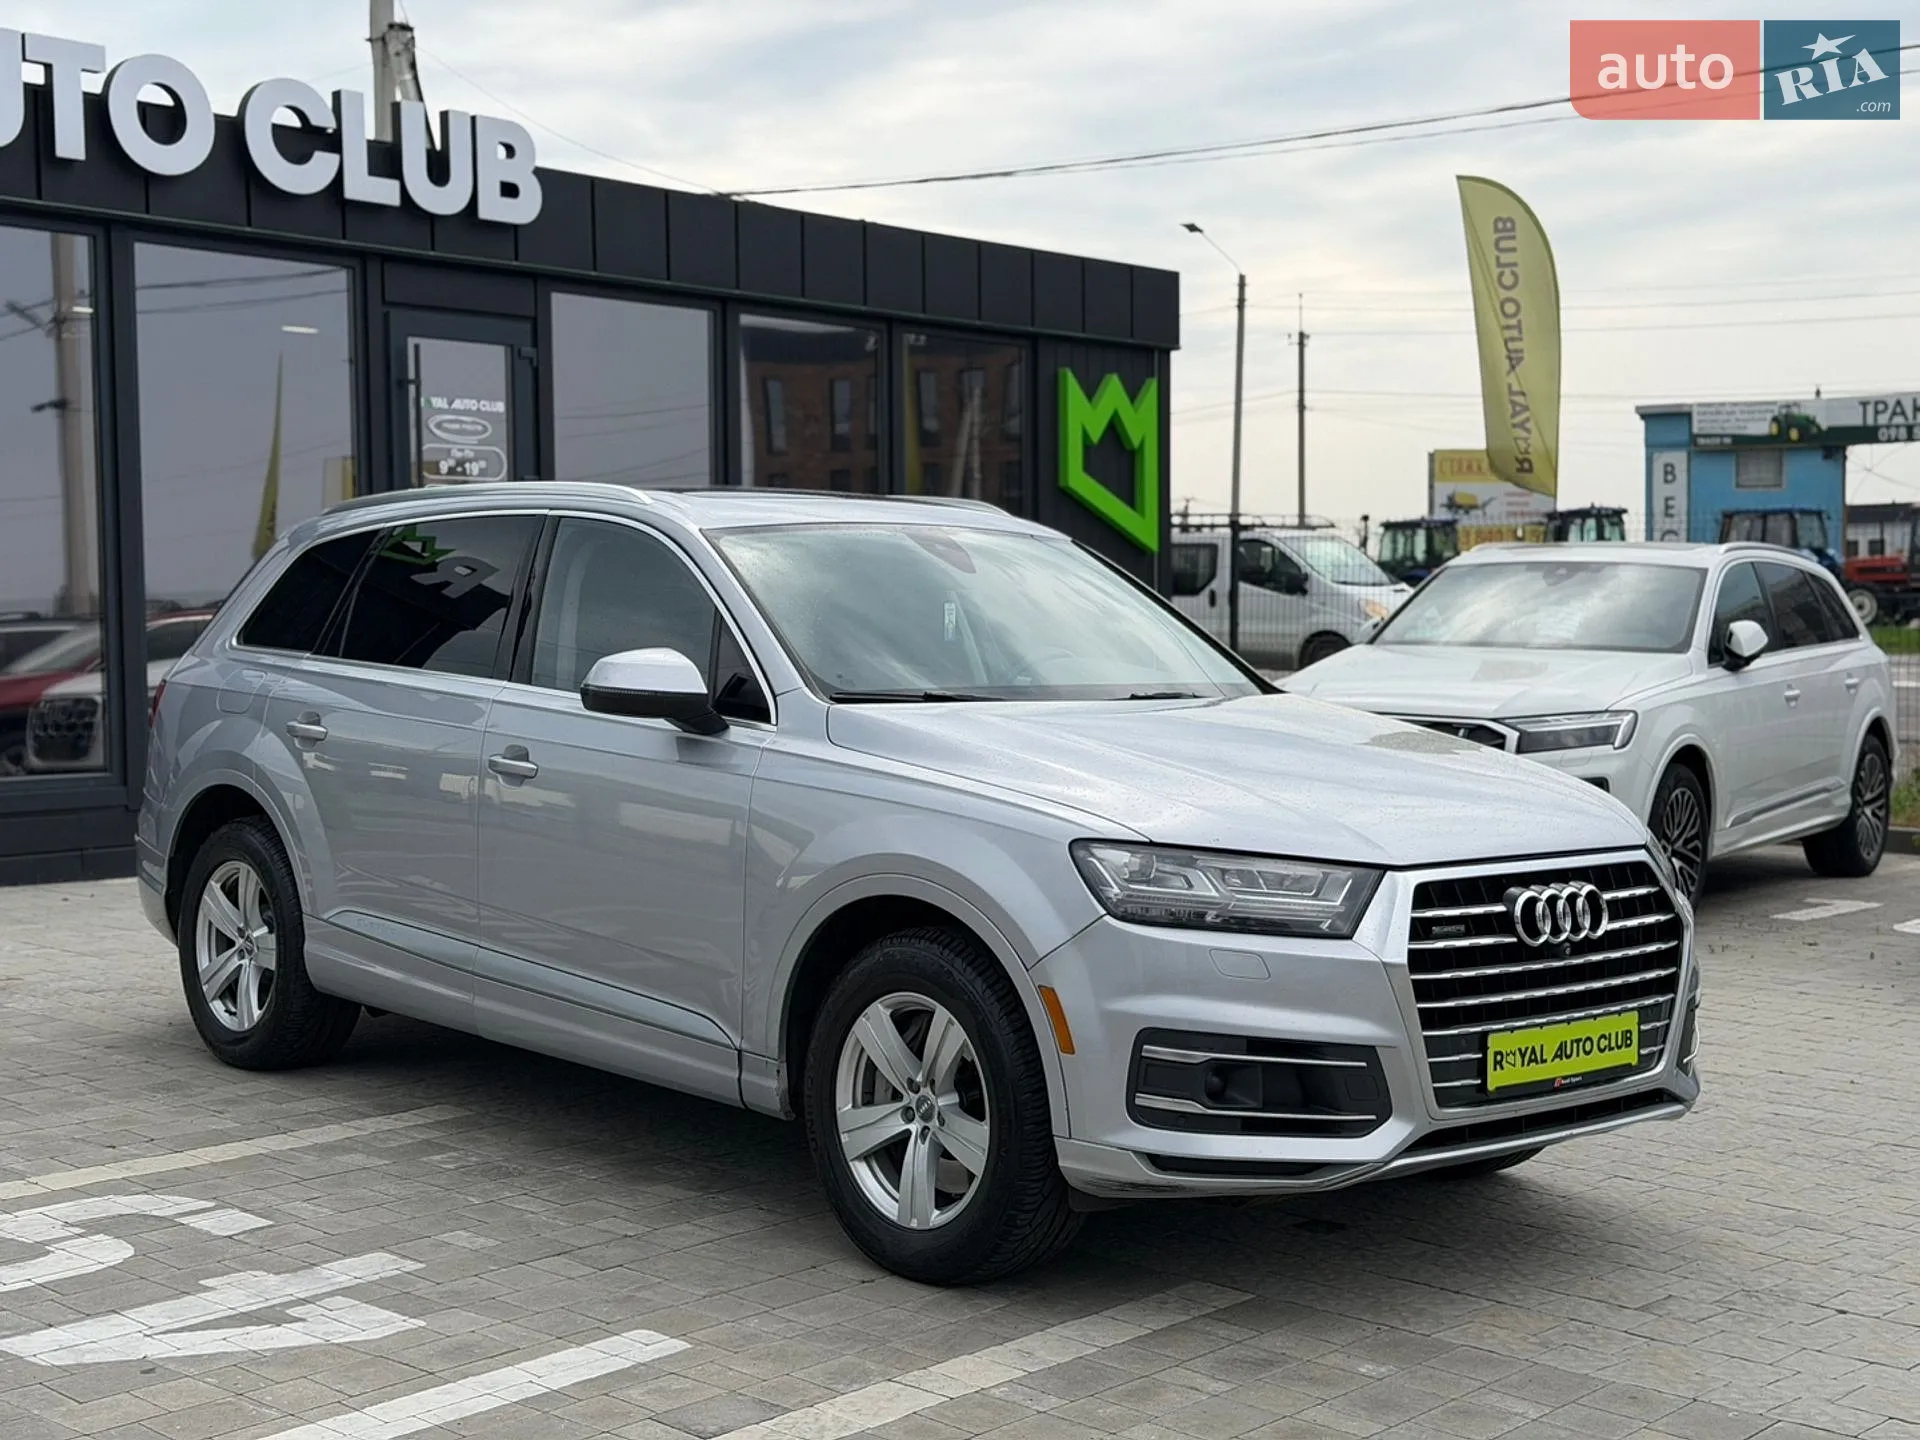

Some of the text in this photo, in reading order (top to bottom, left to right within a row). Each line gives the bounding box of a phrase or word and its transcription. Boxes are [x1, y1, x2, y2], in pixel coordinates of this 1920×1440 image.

[0, 28, 543, 225] TO CLUB
[451, 398, 477, 411] AUTO
[480, 400, 504, 413] CLUB
[1551, 1036, 1594, 1062] AUTO
[1597, 1029, 1633, 1054] CLUB
